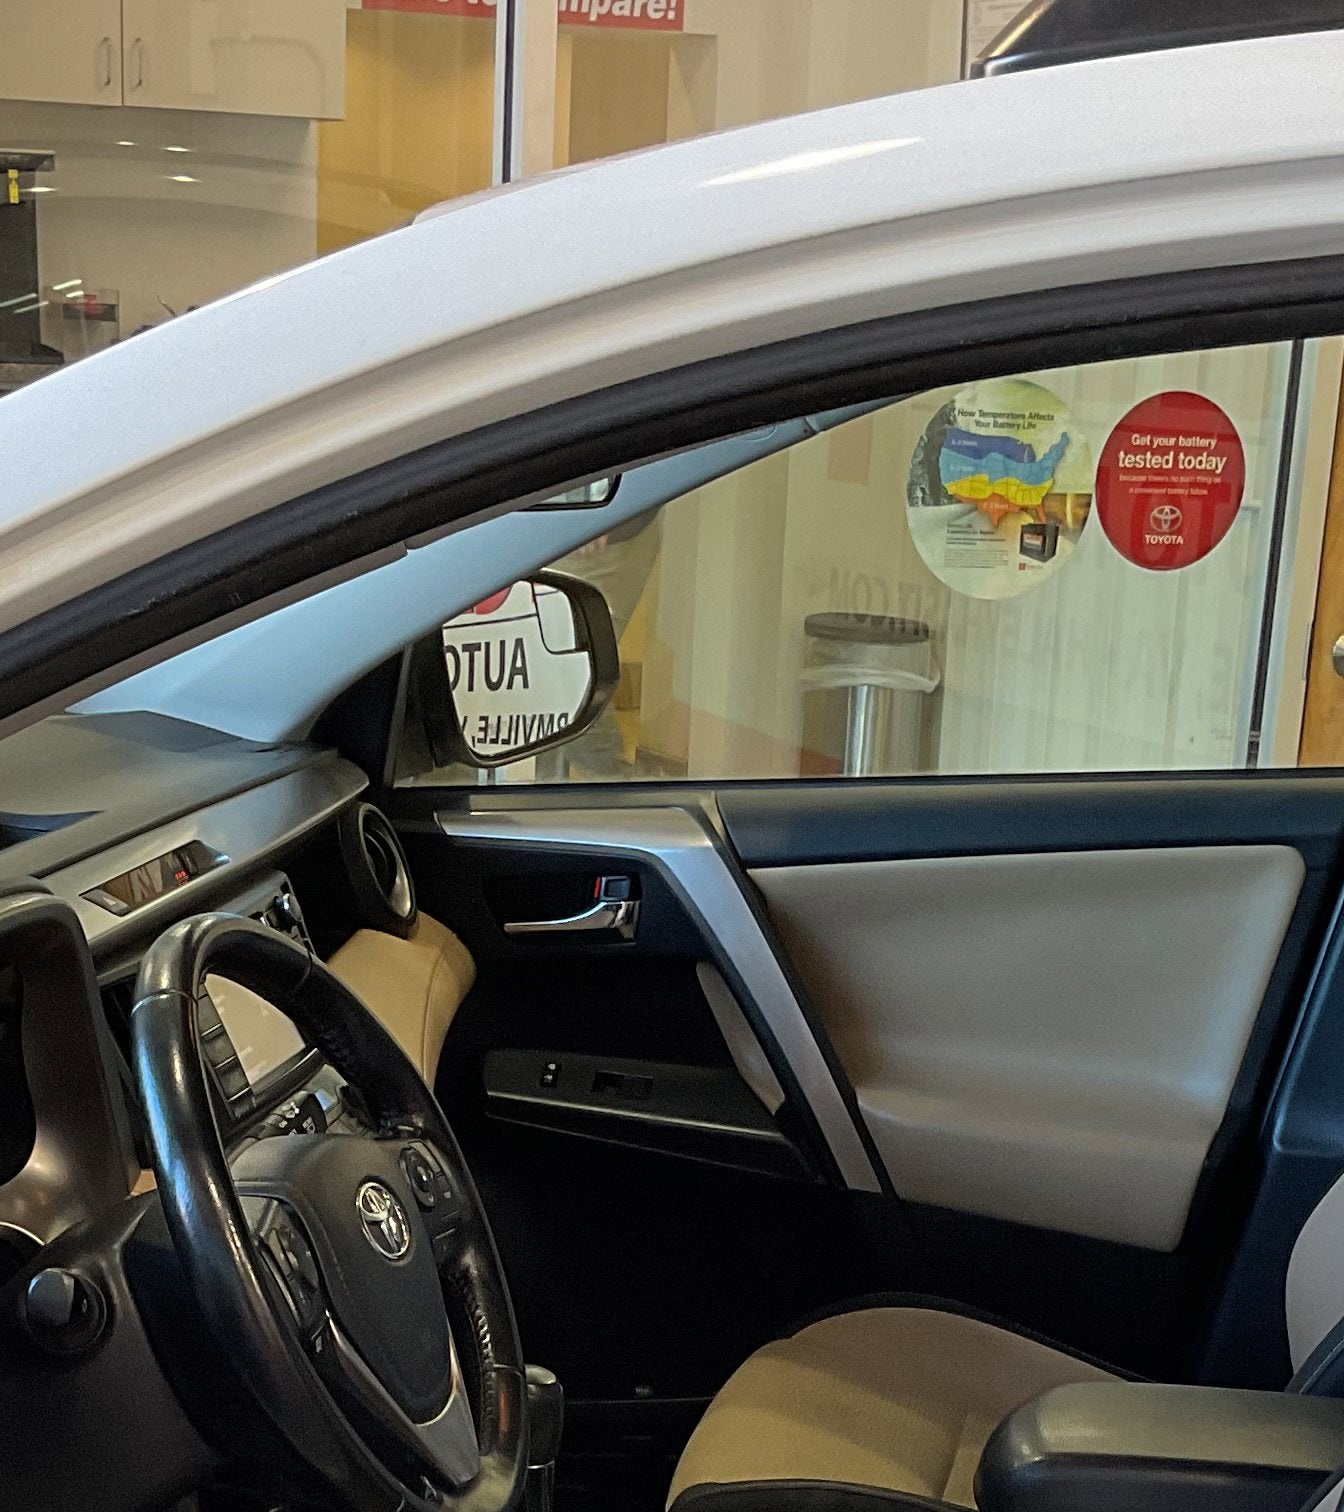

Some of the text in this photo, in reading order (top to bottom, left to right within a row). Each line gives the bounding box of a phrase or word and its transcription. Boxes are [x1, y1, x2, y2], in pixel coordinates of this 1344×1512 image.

[957, 409, 1054, 421] How Temperature Affects
[975, 420, 1037, 430] Your Battery Life
[1131, 433, 1217, 450] Get your battery
[1118, 450, 1227, 474] tested today
[1145, 534, 1184, 545] TOYOTA
